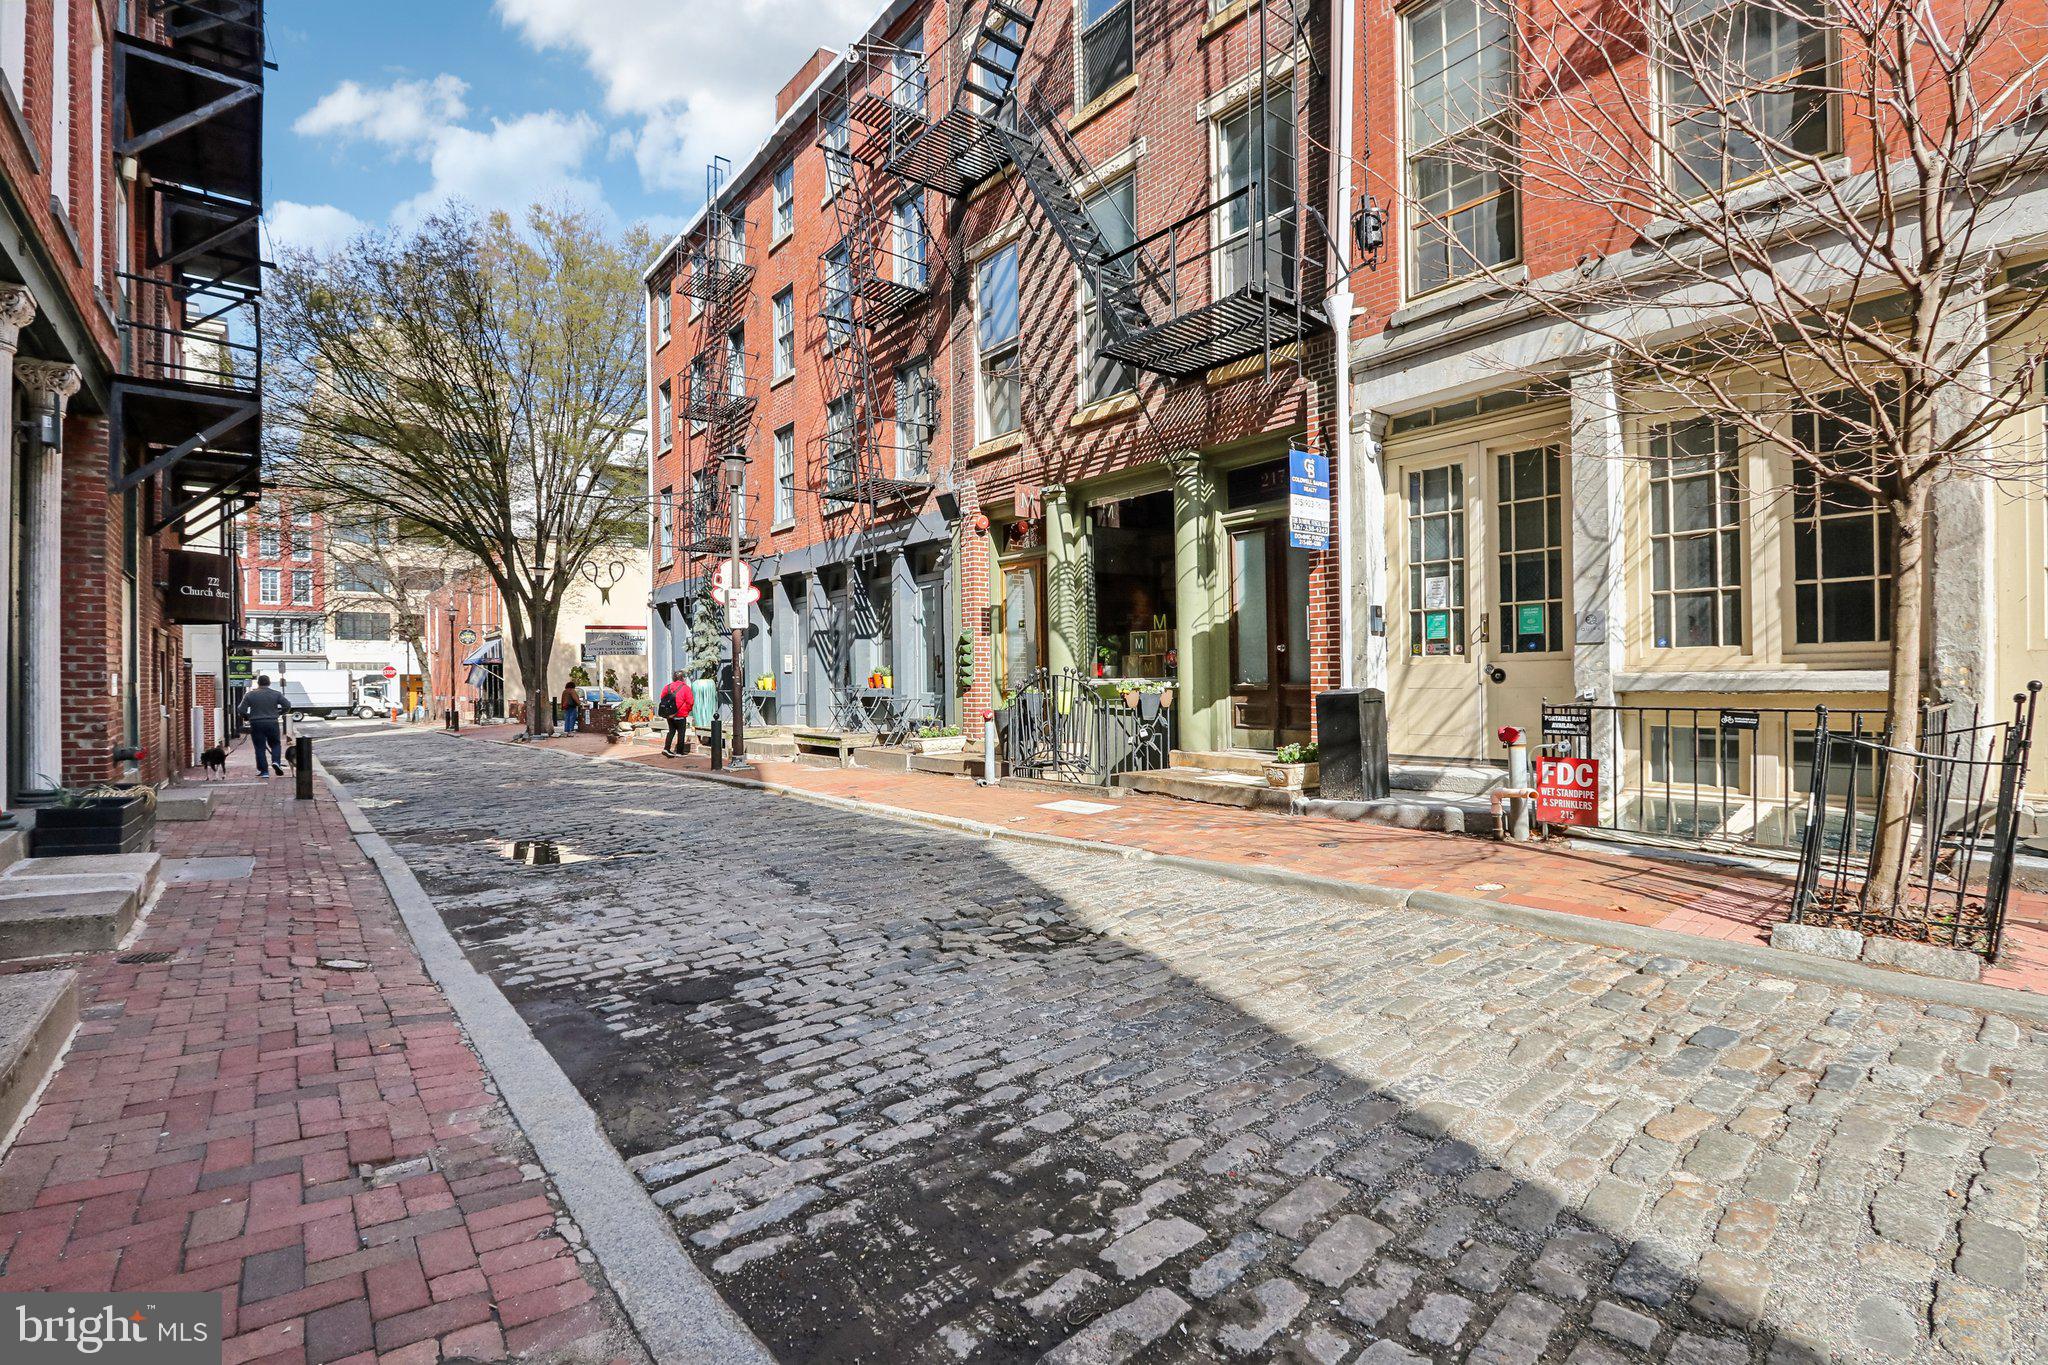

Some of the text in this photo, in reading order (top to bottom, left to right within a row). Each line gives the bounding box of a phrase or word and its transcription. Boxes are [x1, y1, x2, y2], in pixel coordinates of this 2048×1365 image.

[1261, 470, 1285, 487] 217
[1020, 492, 1035, 509] M
[207, 577, 219, 586] 222
[180, 585, 213, 597] Church
[1153, 614, 1166, 630] M
[1135, 638, 1144, 649] M
[1541, 761, 1594, 788] FDC
[1541, 787, 1595, 800] WET STANDPIPE
[1542, 797, 1593, 810] & SPRINKLERS
[1560, 810, 1575, 820] 215
